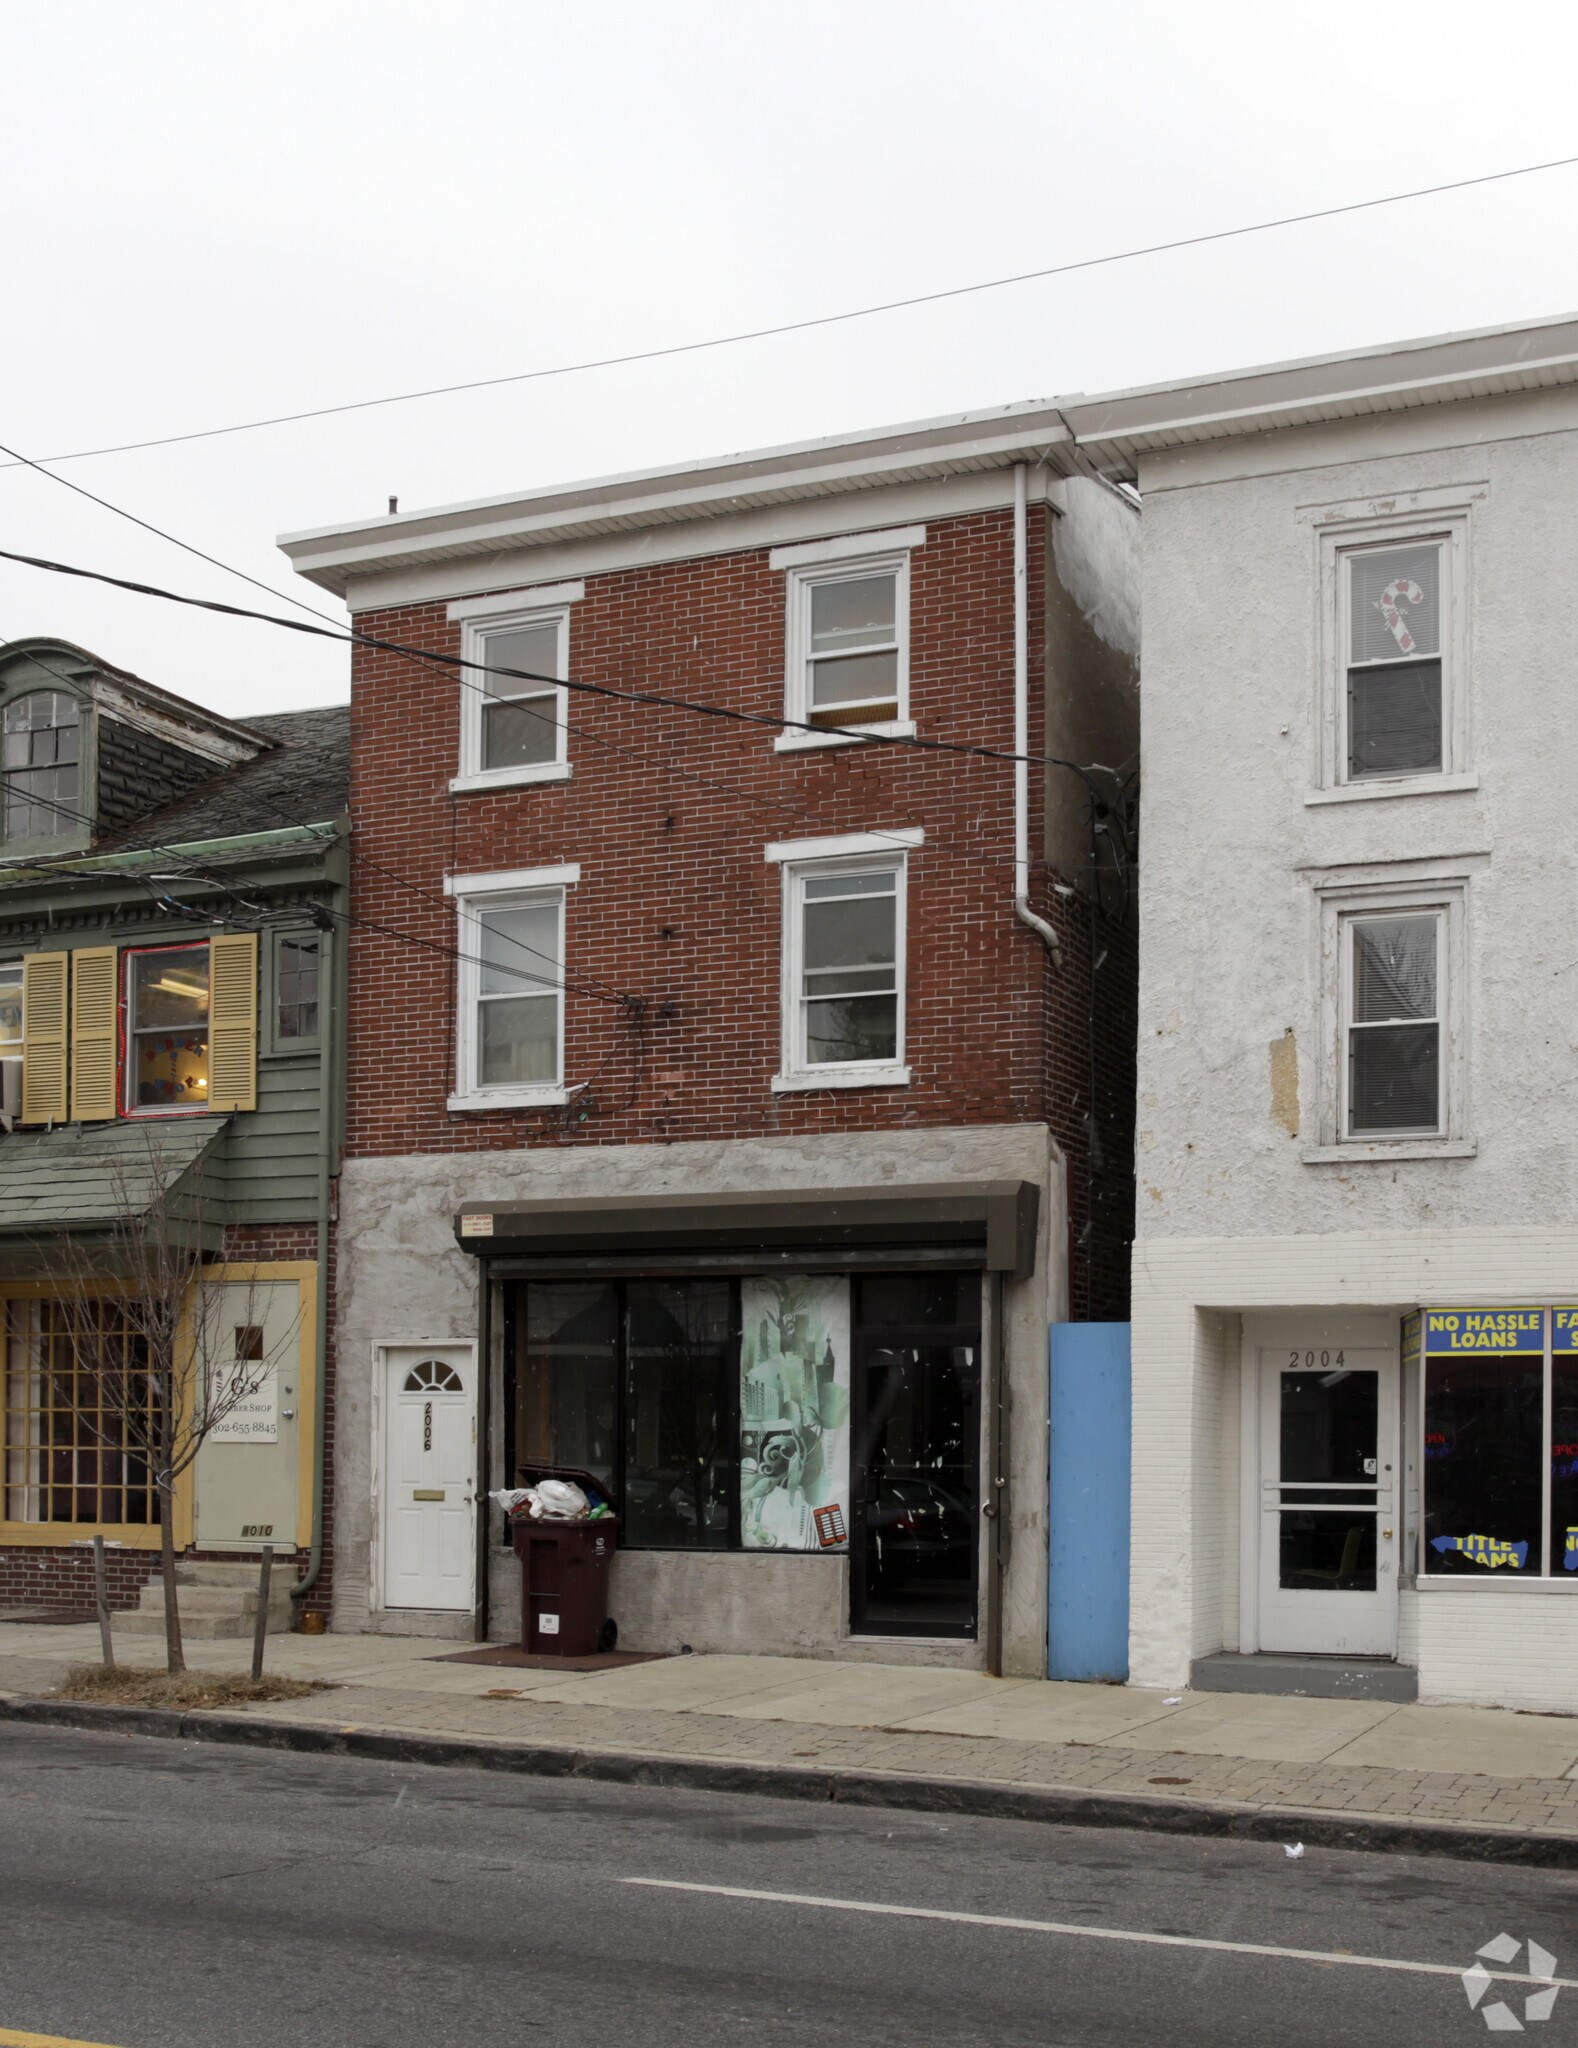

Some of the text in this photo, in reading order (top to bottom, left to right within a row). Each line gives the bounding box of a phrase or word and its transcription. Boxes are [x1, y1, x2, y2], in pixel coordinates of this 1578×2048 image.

[1429, 1315, 1459, 1332] NO
[1466, 1314, 1540, 1331] HASSLE
[1451, 1331, 1518, 1348] LOANS
[1288, 1350, 1345, 1368] 2004
[249, 1403, 272, 1413] SHOP
[212, 1422, 277, 1434] 302-655-8845
[424, 1402, 432, 1451] 2006
[1453, 1535, 1512, 1551] TITLE
